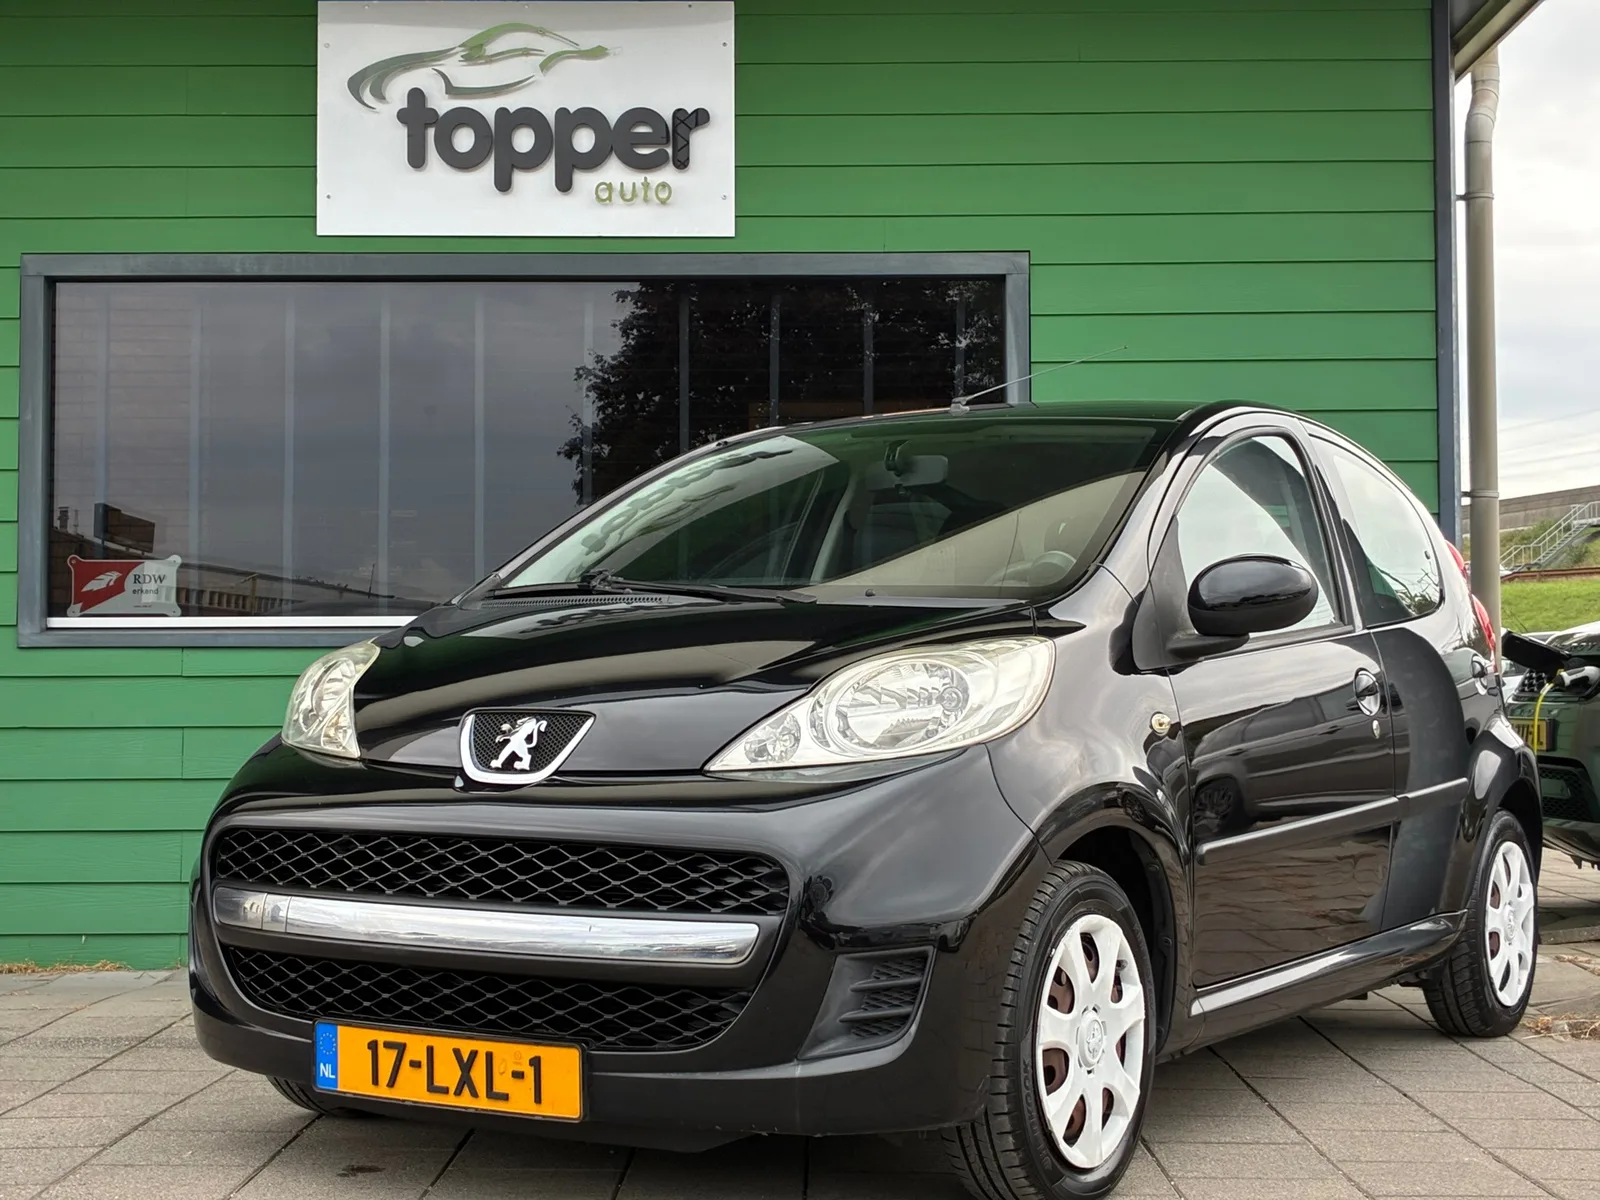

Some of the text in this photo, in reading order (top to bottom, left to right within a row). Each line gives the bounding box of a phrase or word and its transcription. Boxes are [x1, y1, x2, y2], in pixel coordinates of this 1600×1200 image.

[396, 87, 710, 193] topper
[594, 177, 673, 203] auto
[133, 574, 166, 584] RDW
[319, 1062, 335, 1079] NL
[367, 1039, 542, 1104] 17-LXL-1
